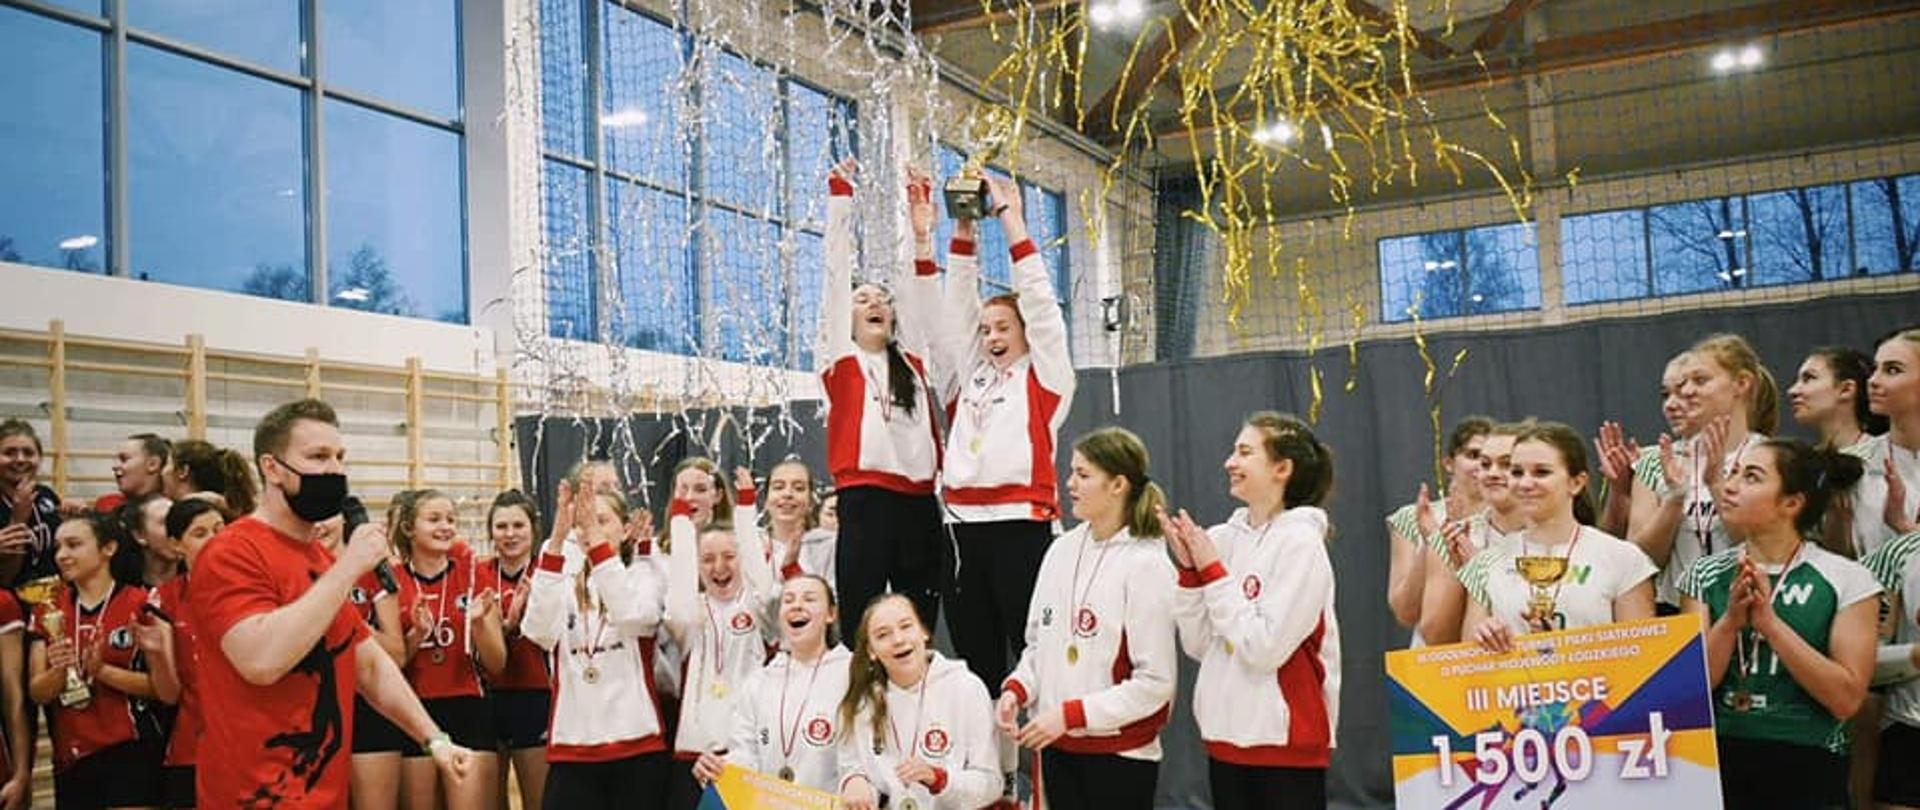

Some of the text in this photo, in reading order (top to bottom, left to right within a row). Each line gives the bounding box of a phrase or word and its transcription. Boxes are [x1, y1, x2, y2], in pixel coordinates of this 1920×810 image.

[1466, 677, 1608, 711] III MIEJSCE
[1474, 725, 1593, 785] 500
[1616, 711, 1672, 780] zł
